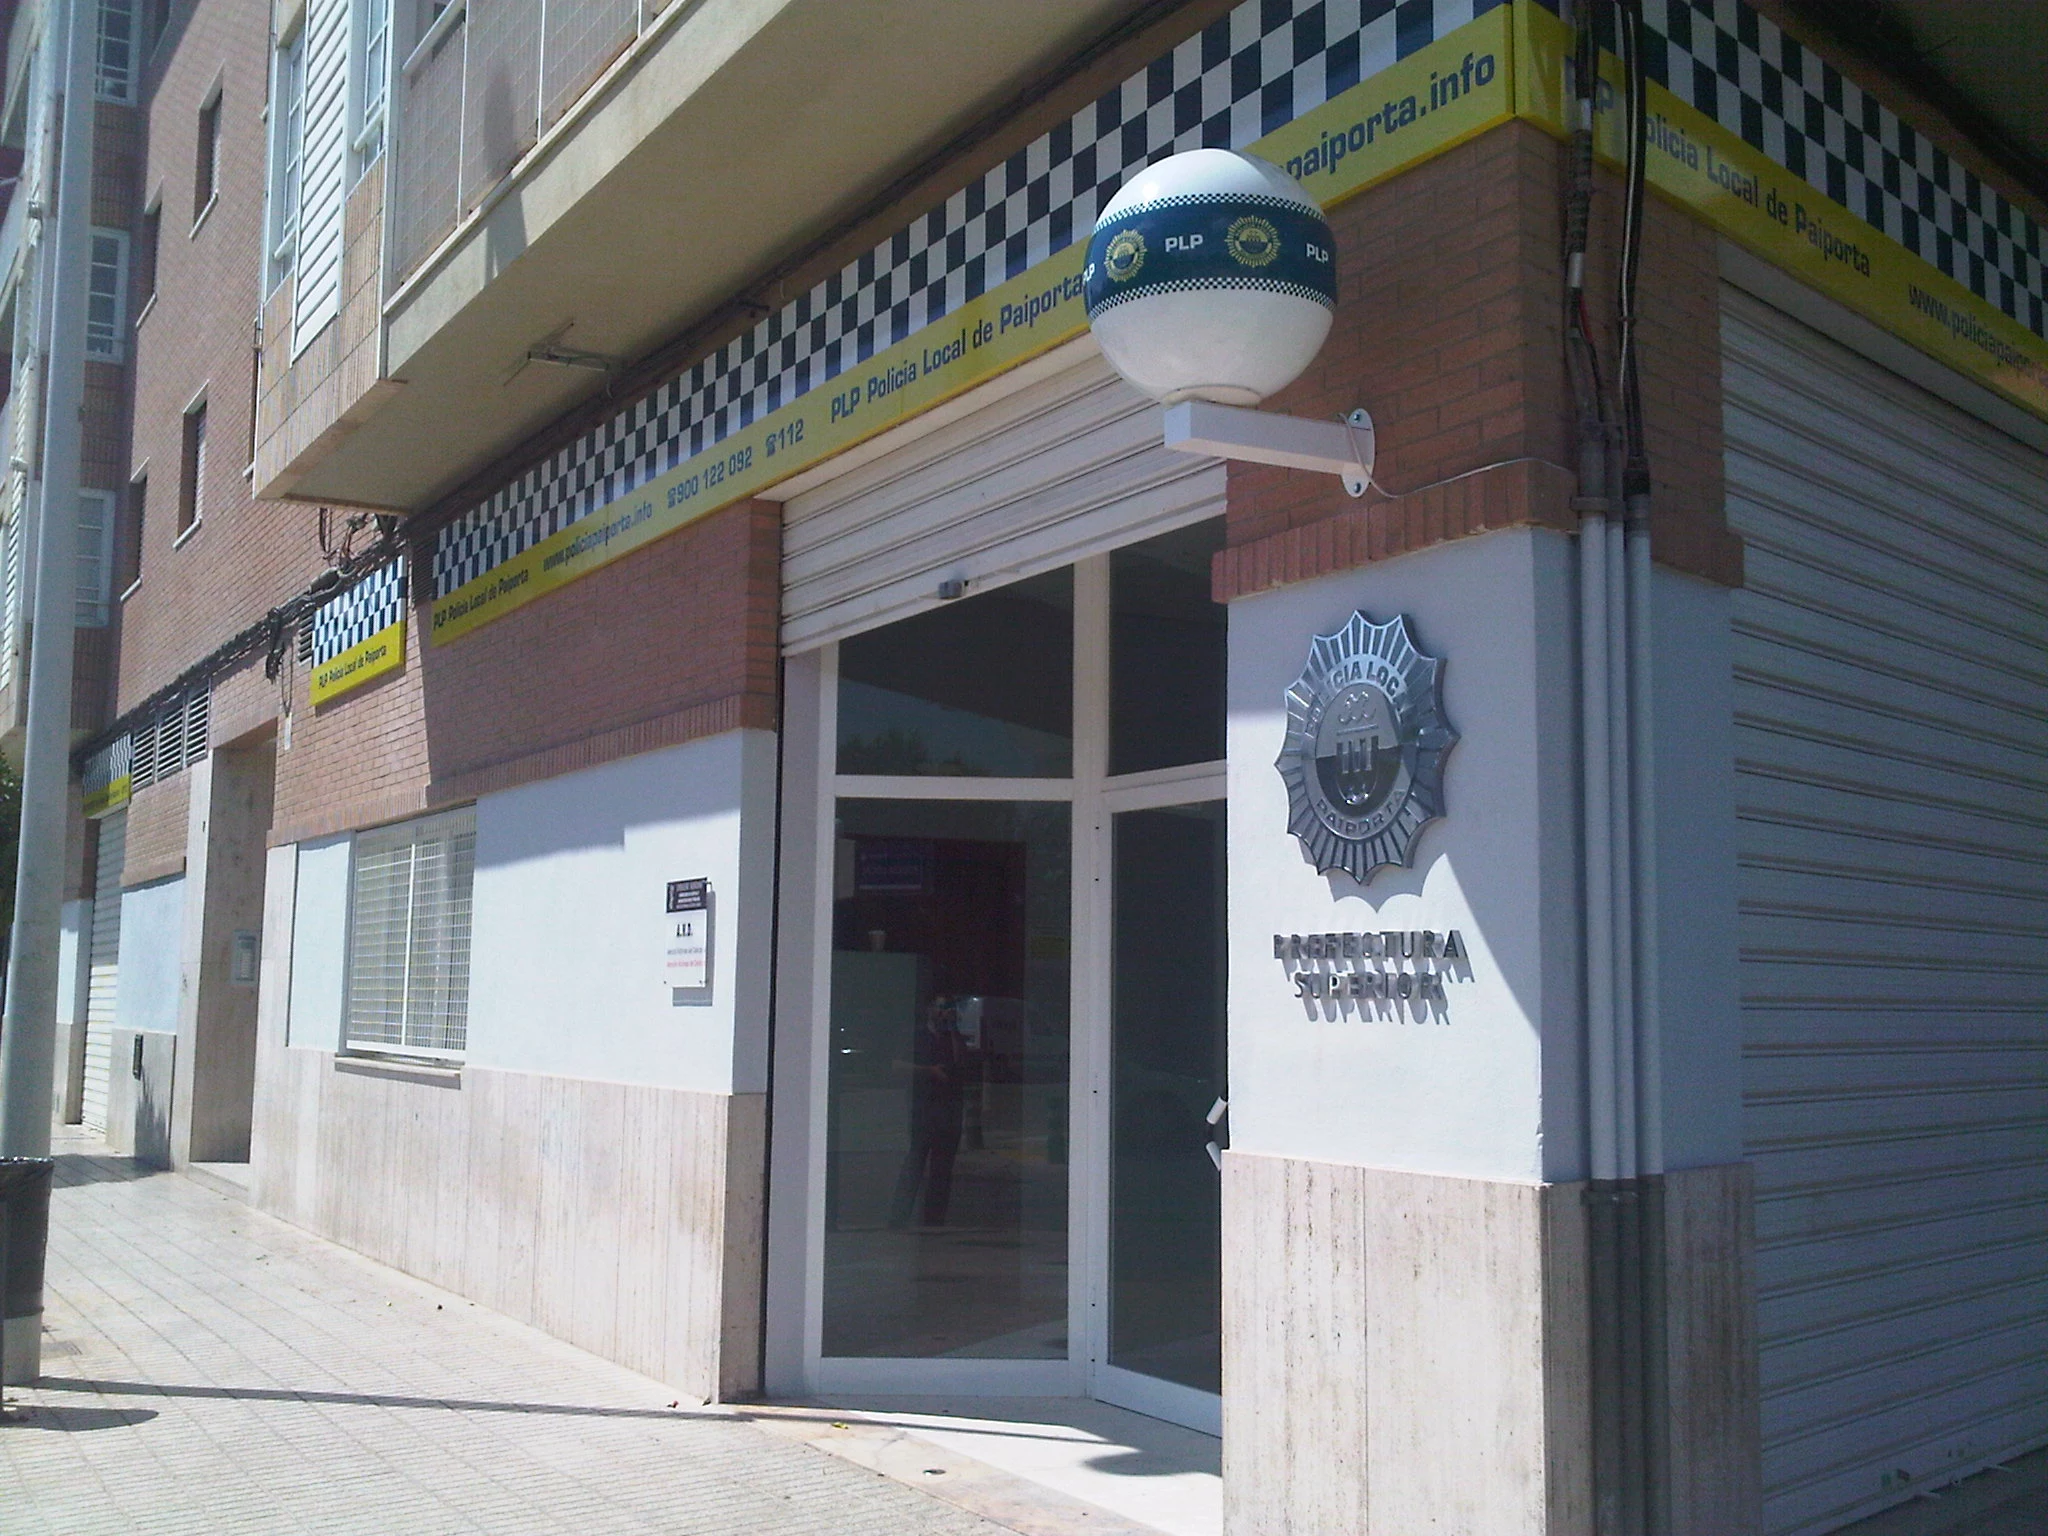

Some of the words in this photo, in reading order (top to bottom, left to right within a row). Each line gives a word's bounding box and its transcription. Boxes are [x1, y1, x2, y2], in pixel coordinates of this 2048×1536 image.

[1280, 52, 1495, 181] paiporta.info
[1646, 112, 1699, 172] olicia
[1706, 145, 1759, 208] Local
[1766, 187, 1788, 225] de
[1795, 202, 1870, 278] Paiporta
[1164, 233, 1204, 253] PLP
[1305, 242, 1329, 264] PLP
[831, 386, 860, 424] PLP
[867, 360, 917, 404] Policia
[923, 328, 967, 376] Local
[972, 319, 993, 349] de
[1000, 273, 1084, 335] Paiporta
[778, 418, 804, 450] 112
[677, 475, 699, 504] 900
[703, 461, 725, 489] 122
[728, 445, 752, 477] 092
[1273, 929, 1467, 960] PREFECTURA
[1294, 971, 1442, 1000] SUPERIOR
